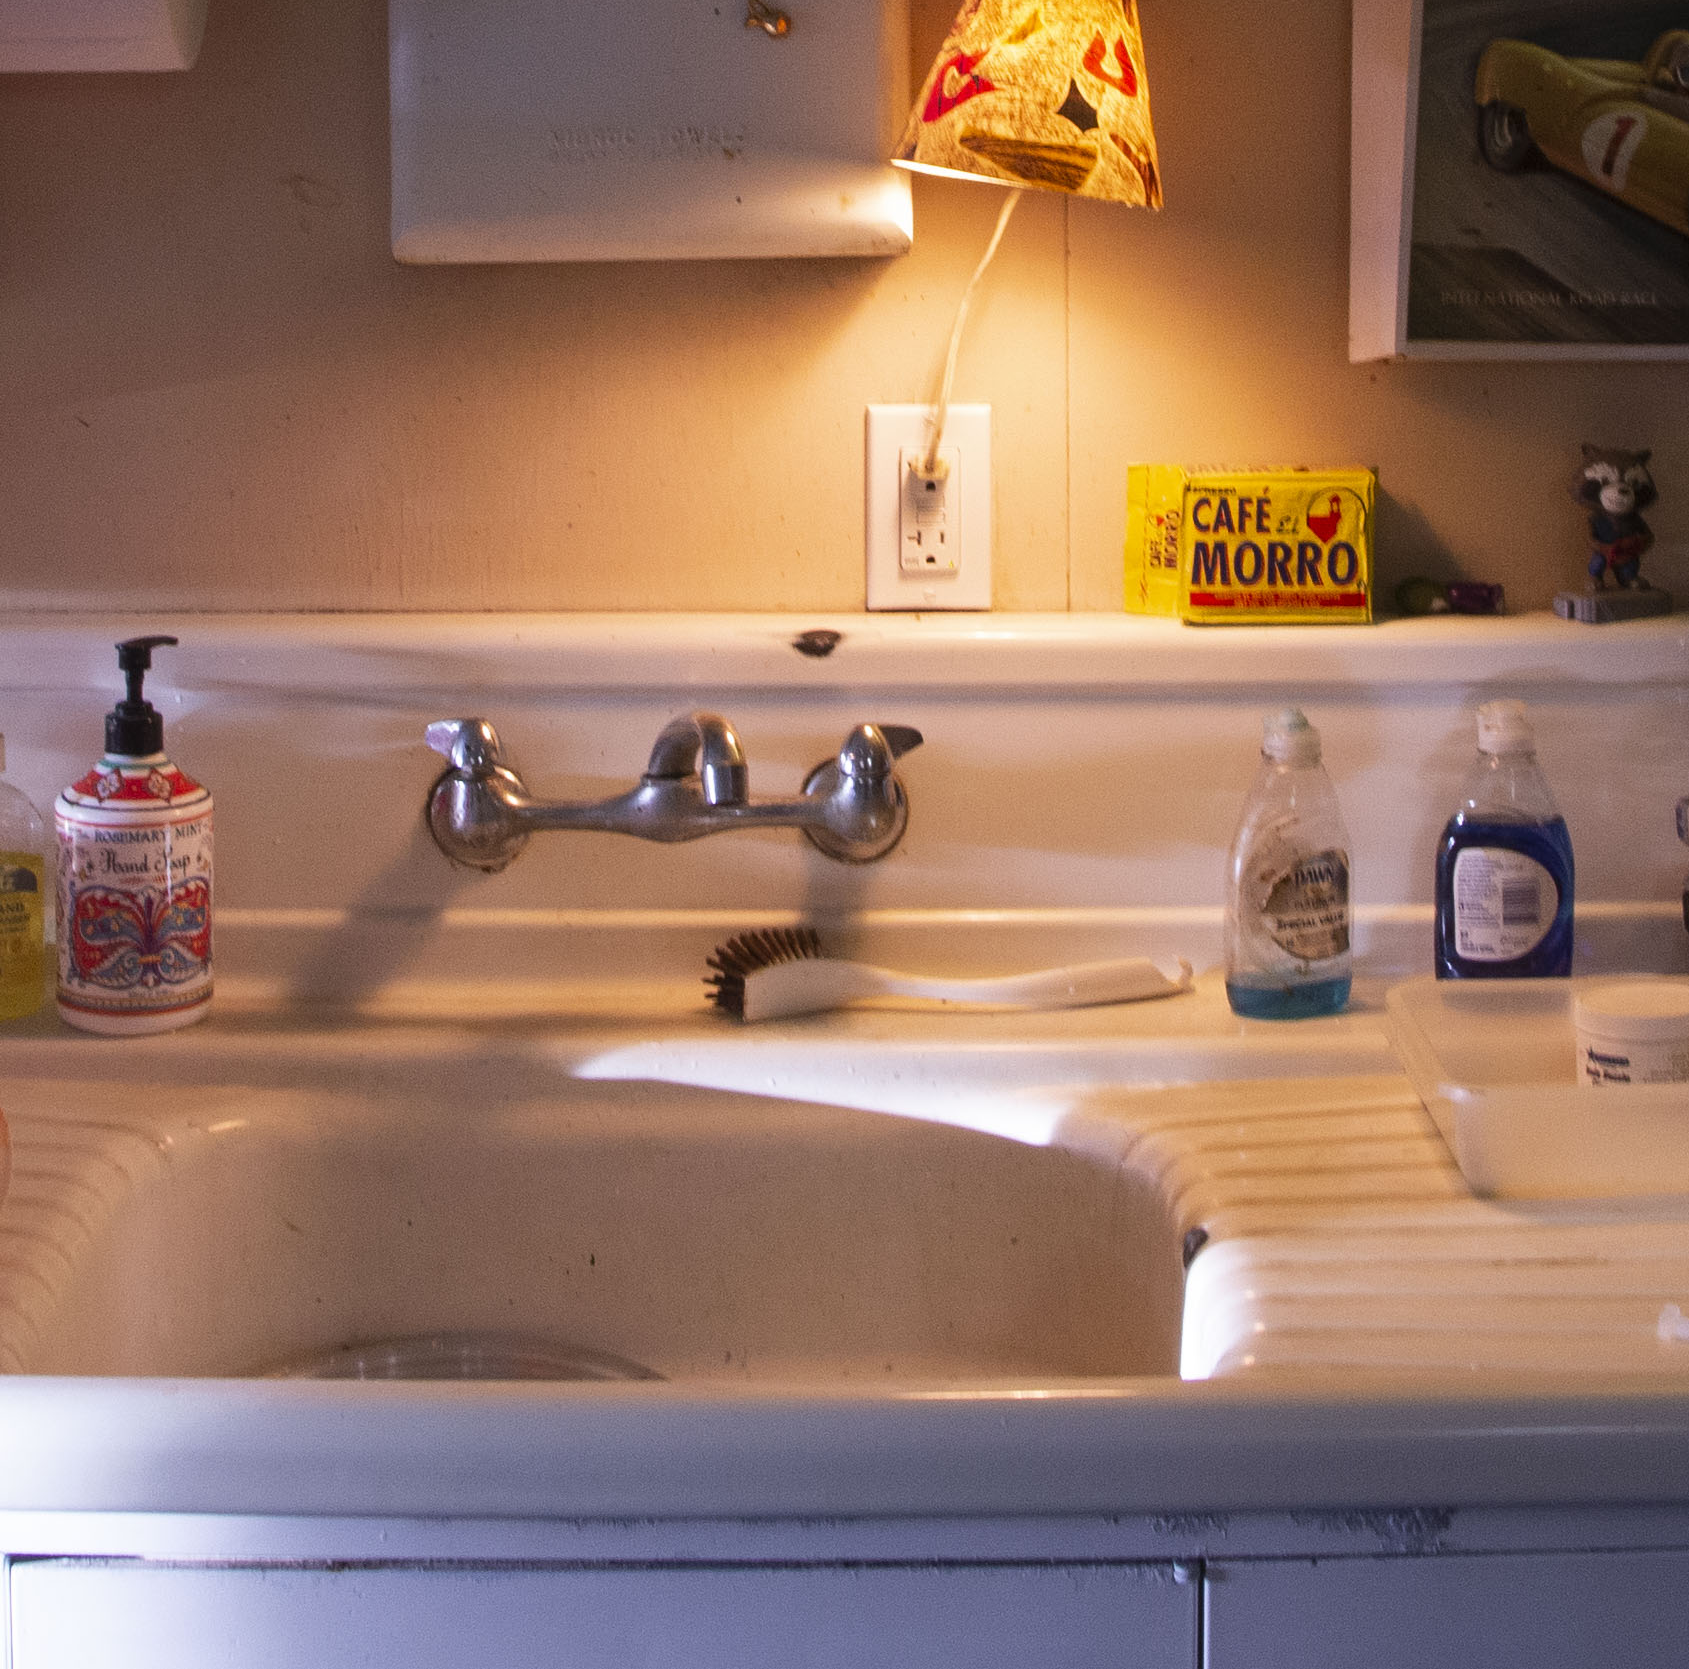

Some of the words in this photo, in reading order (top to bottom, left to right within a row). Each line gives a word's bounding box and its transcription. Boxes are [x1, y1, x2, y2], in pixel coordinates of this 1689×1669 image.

[1603, 117, 1636, 175] 1
[1192, 486, 1273, 533] CAFÉ
[1191, 541, 1359, 586] MORRO
[94, 827, 166, 845] ROSEMARY
